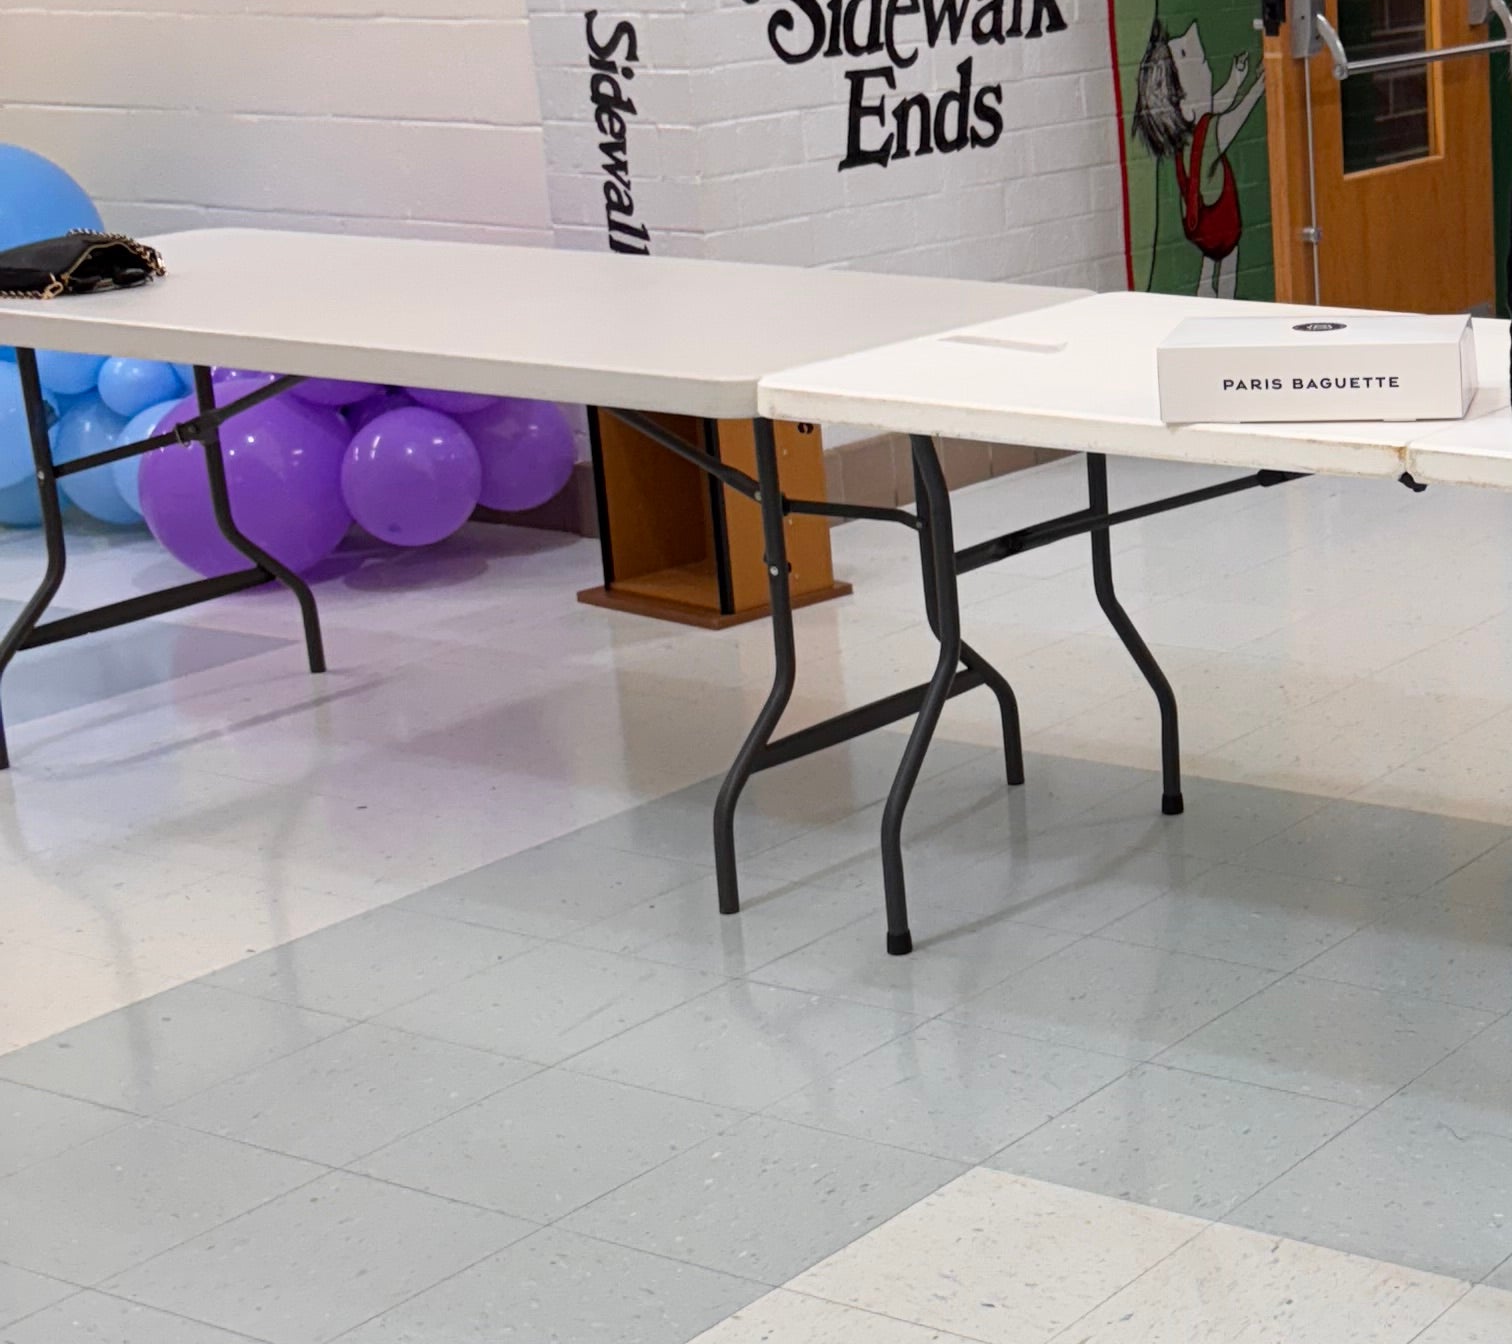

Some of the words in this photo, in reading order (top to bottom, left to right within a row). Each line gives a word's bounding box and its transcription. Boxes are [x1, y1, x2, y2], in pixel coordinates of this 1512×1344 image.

[838, 56, 1003, 172] Ends
[1223, 378, 1282, 391] PARIS
[1292, 376, 1400, 390] BAGUETTE
